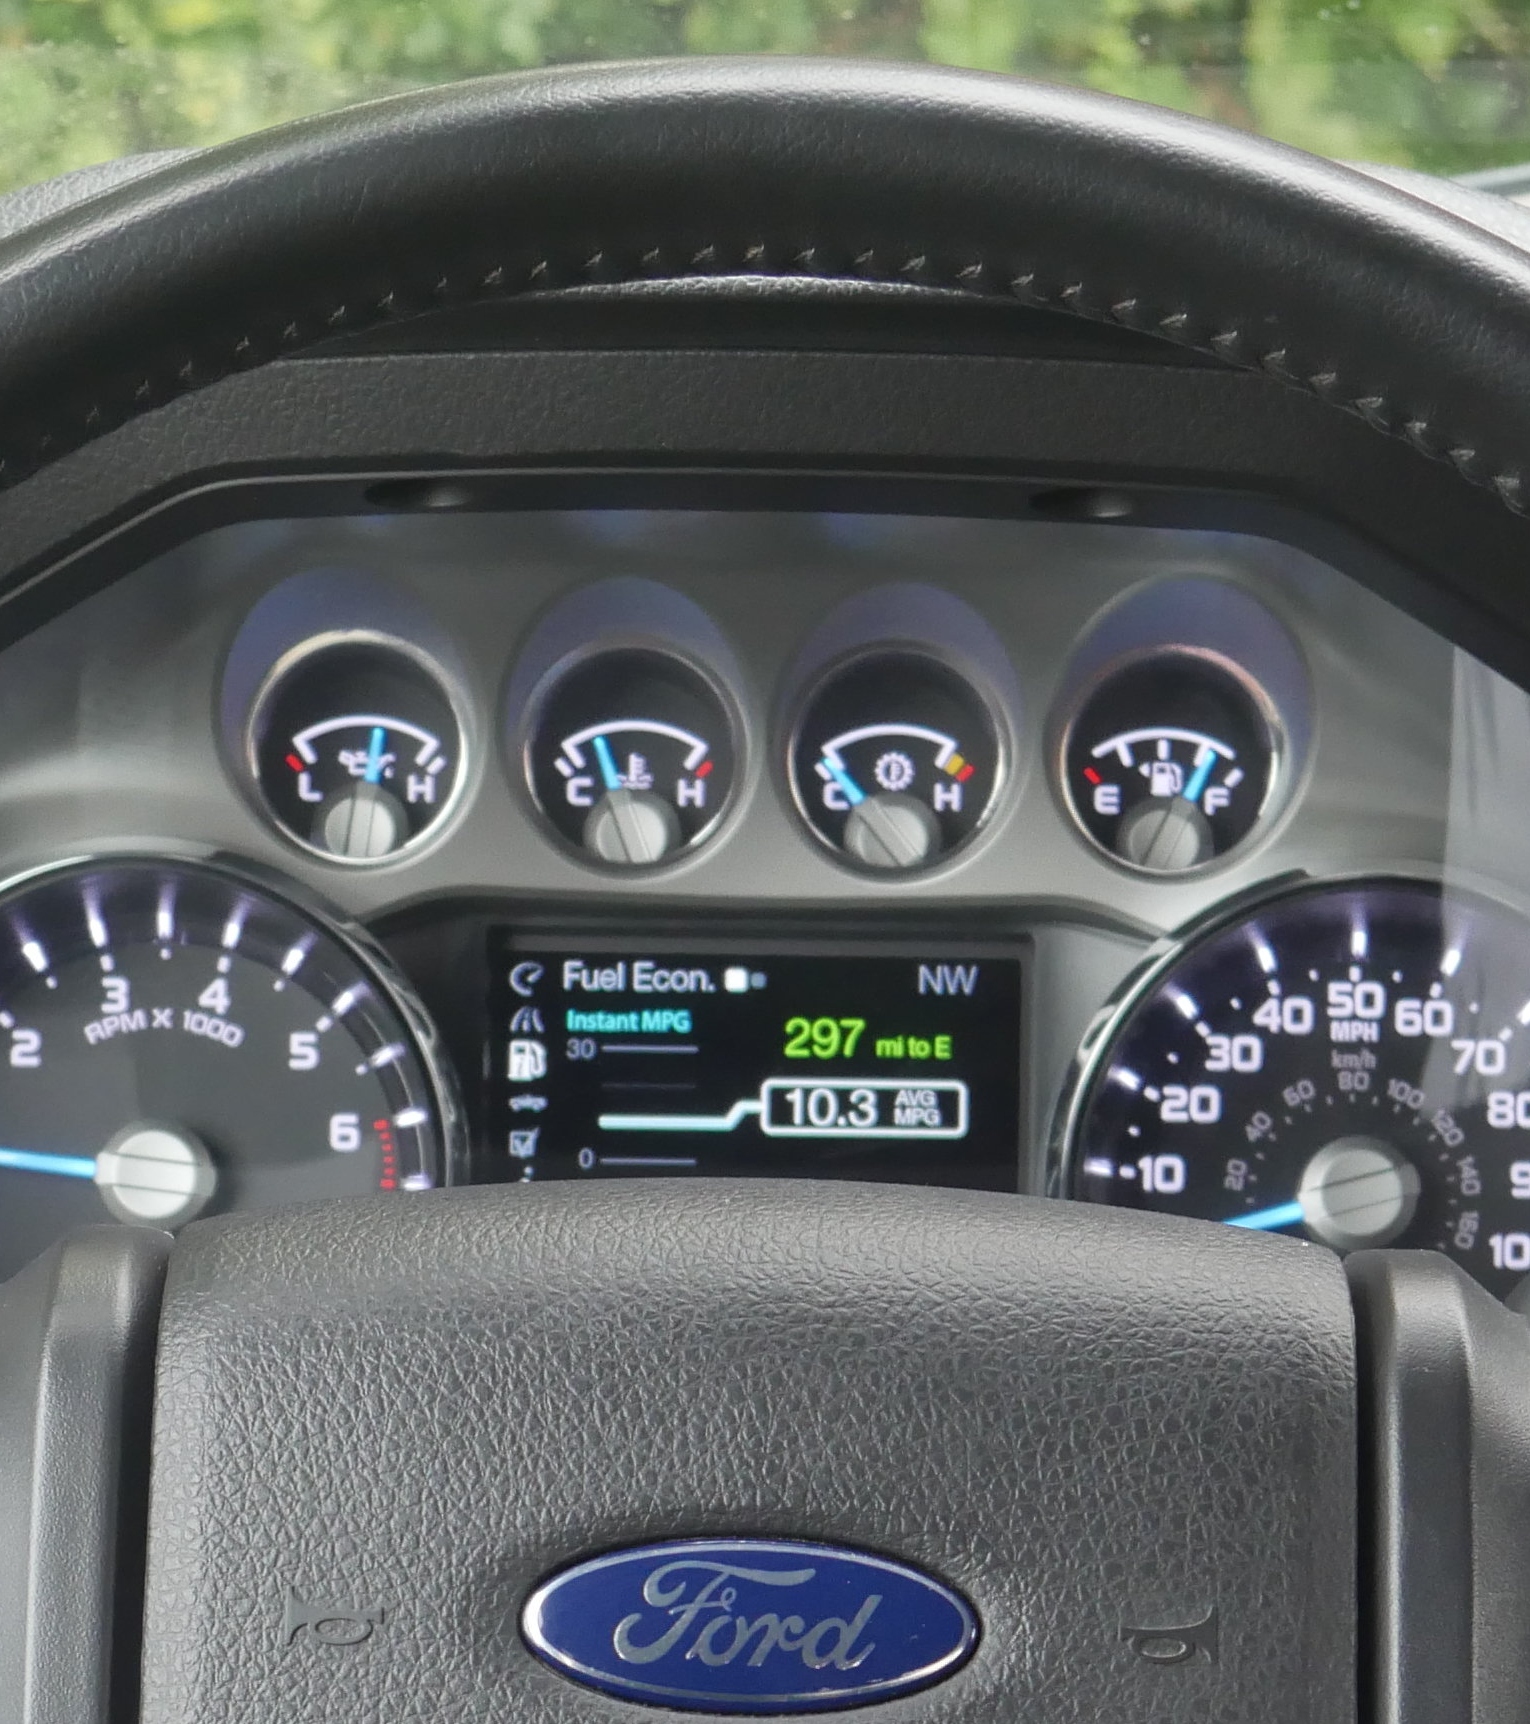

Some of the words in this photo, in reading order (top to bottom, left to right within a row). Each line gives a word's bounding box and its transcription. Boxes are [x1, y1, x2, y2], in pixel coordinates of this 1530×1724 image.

[298, 772, 323, 802] L
[406, 774, 436, 803] H
[566, 776, 594, 807] C
[677, 778, 706, 808] H
[933, 783, 963, 812] H
[1093, 784, 1121, 815] E
[1204, 786, 1231, 816] F
[563, 961, 626, 993] Fuel
[633, 961, 716, 994] Econ.
[917, 964, 978, 996] NW
[101, 976, 131, 1014] 3
[197, 978, 231, 1015] 4
[1327, 981, 1386, 1019] 50
[84, 1009, 148, 1045] RPM
[182, 1008, 245, 1048] 1000
[566, 1009, 638, 1033] Instant
[642, 1010, 692, 1034] MPG
[1253, 997, 1314, 1035] 40
[1330, 1020, 1380, 1043] MPH
[1394, 999, 1454, 1037] 60
[10, 1030, 42, 1069] 2
[289, 1032, 320, 1071] 5
[566, 1037, 596, 1061] 30
[783, 1018, 866, 1059] 297
[876, 1037, 904, 1058] mi
[907, 1038, 928, 1059] to
[934, 1036, 952, 1060] E
[1205, 1035, 1264, 1073] 30
[1330, 1048, 1377, 1071] km/h
[1451, 1038, 1507, 1076] 70
[1283, 1078, 1316, 1108] 60
[1336, 1070, 1370, 1092] 80
[1387, 1078, 1427, 1110] 100
[785, 1088, 878, 1128] 10.3
[894, 1089, 937, 1107] AVG
[1161, 1085, 1221, 1124] 20
[329, 1113, 361, 1152] 6
[894, 1107, 942, 1127] MPG
[1245, 1111, 1273, 1143] 40
[1430, 1108, 1465, 1148] 120
[578, 1148, 595, 1170] 0
[1137, 1154, 1186, 1195] 10
[1455, 1155, 1481, 1196] 140
[613, 1560, 883, 1671] Ford
